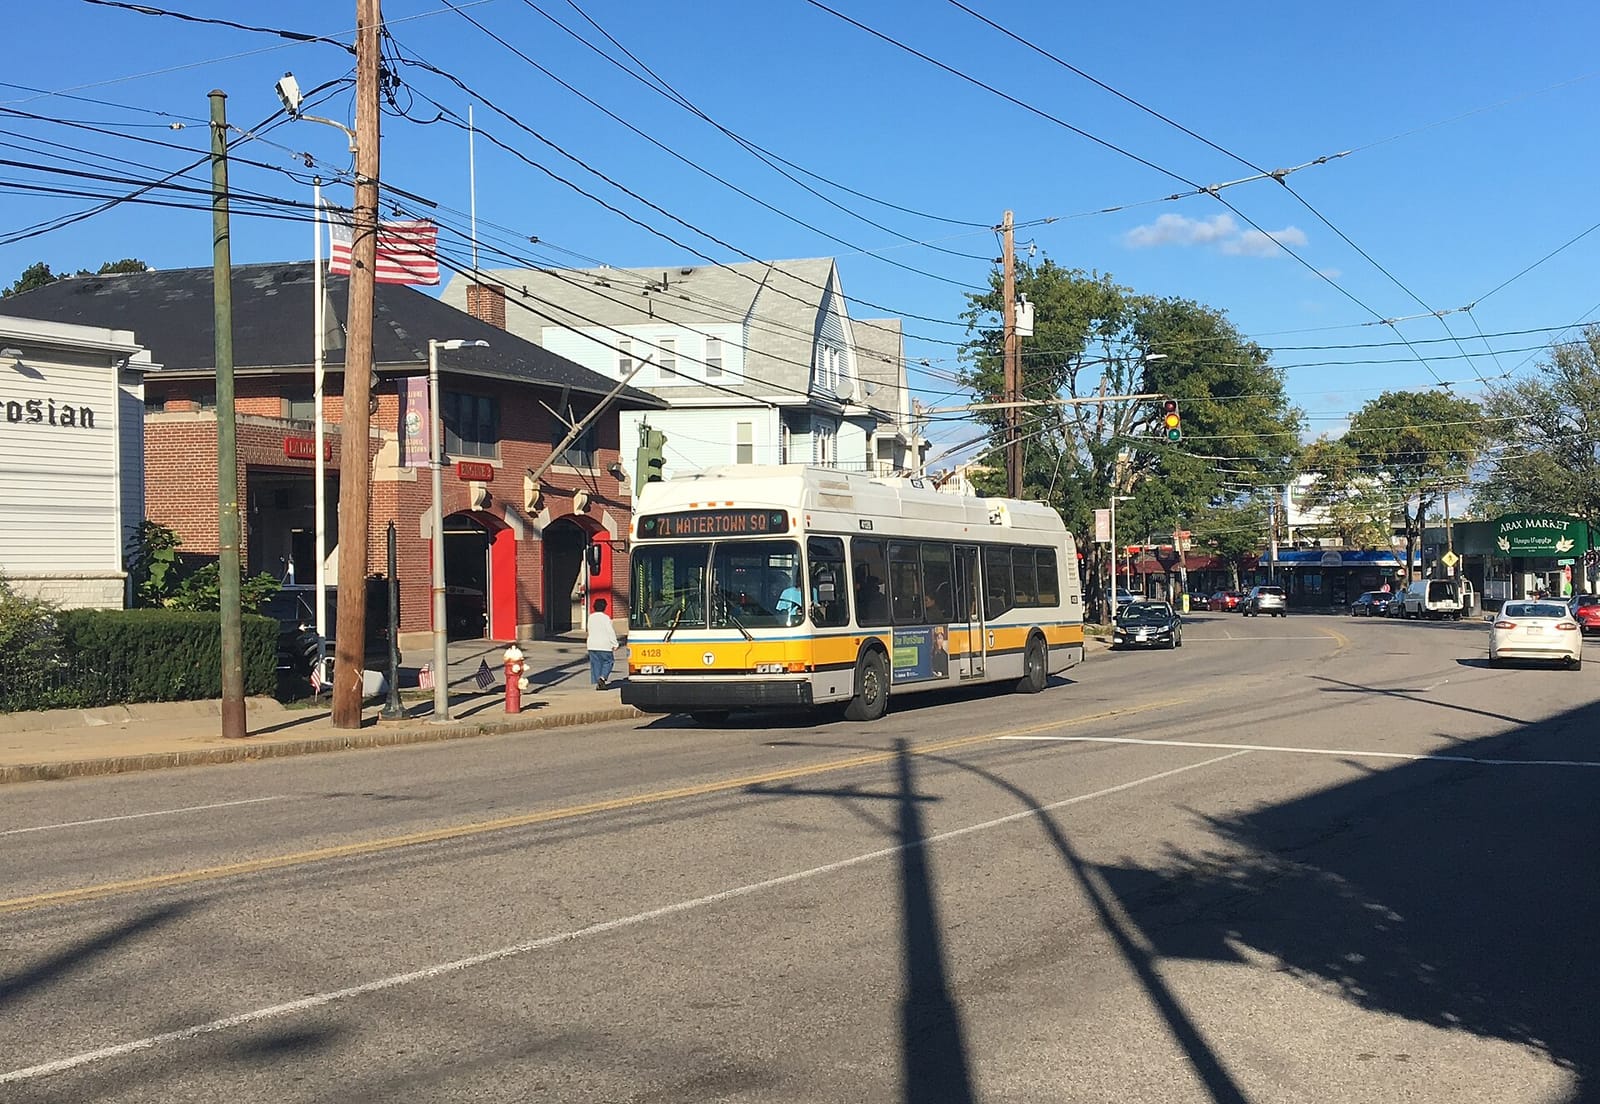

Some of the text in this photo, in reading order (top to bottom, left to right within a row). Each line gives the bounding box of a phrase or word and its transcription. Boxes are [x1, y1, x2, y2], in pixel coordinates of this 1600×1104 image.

[0, 397, 94, 429] osian
[657, 514, 766, 535] 71 WATERTOWN SQ
[1500, 519, 1570, 533] ARAX MARKET
[641, 649, 662, 658] 4128
